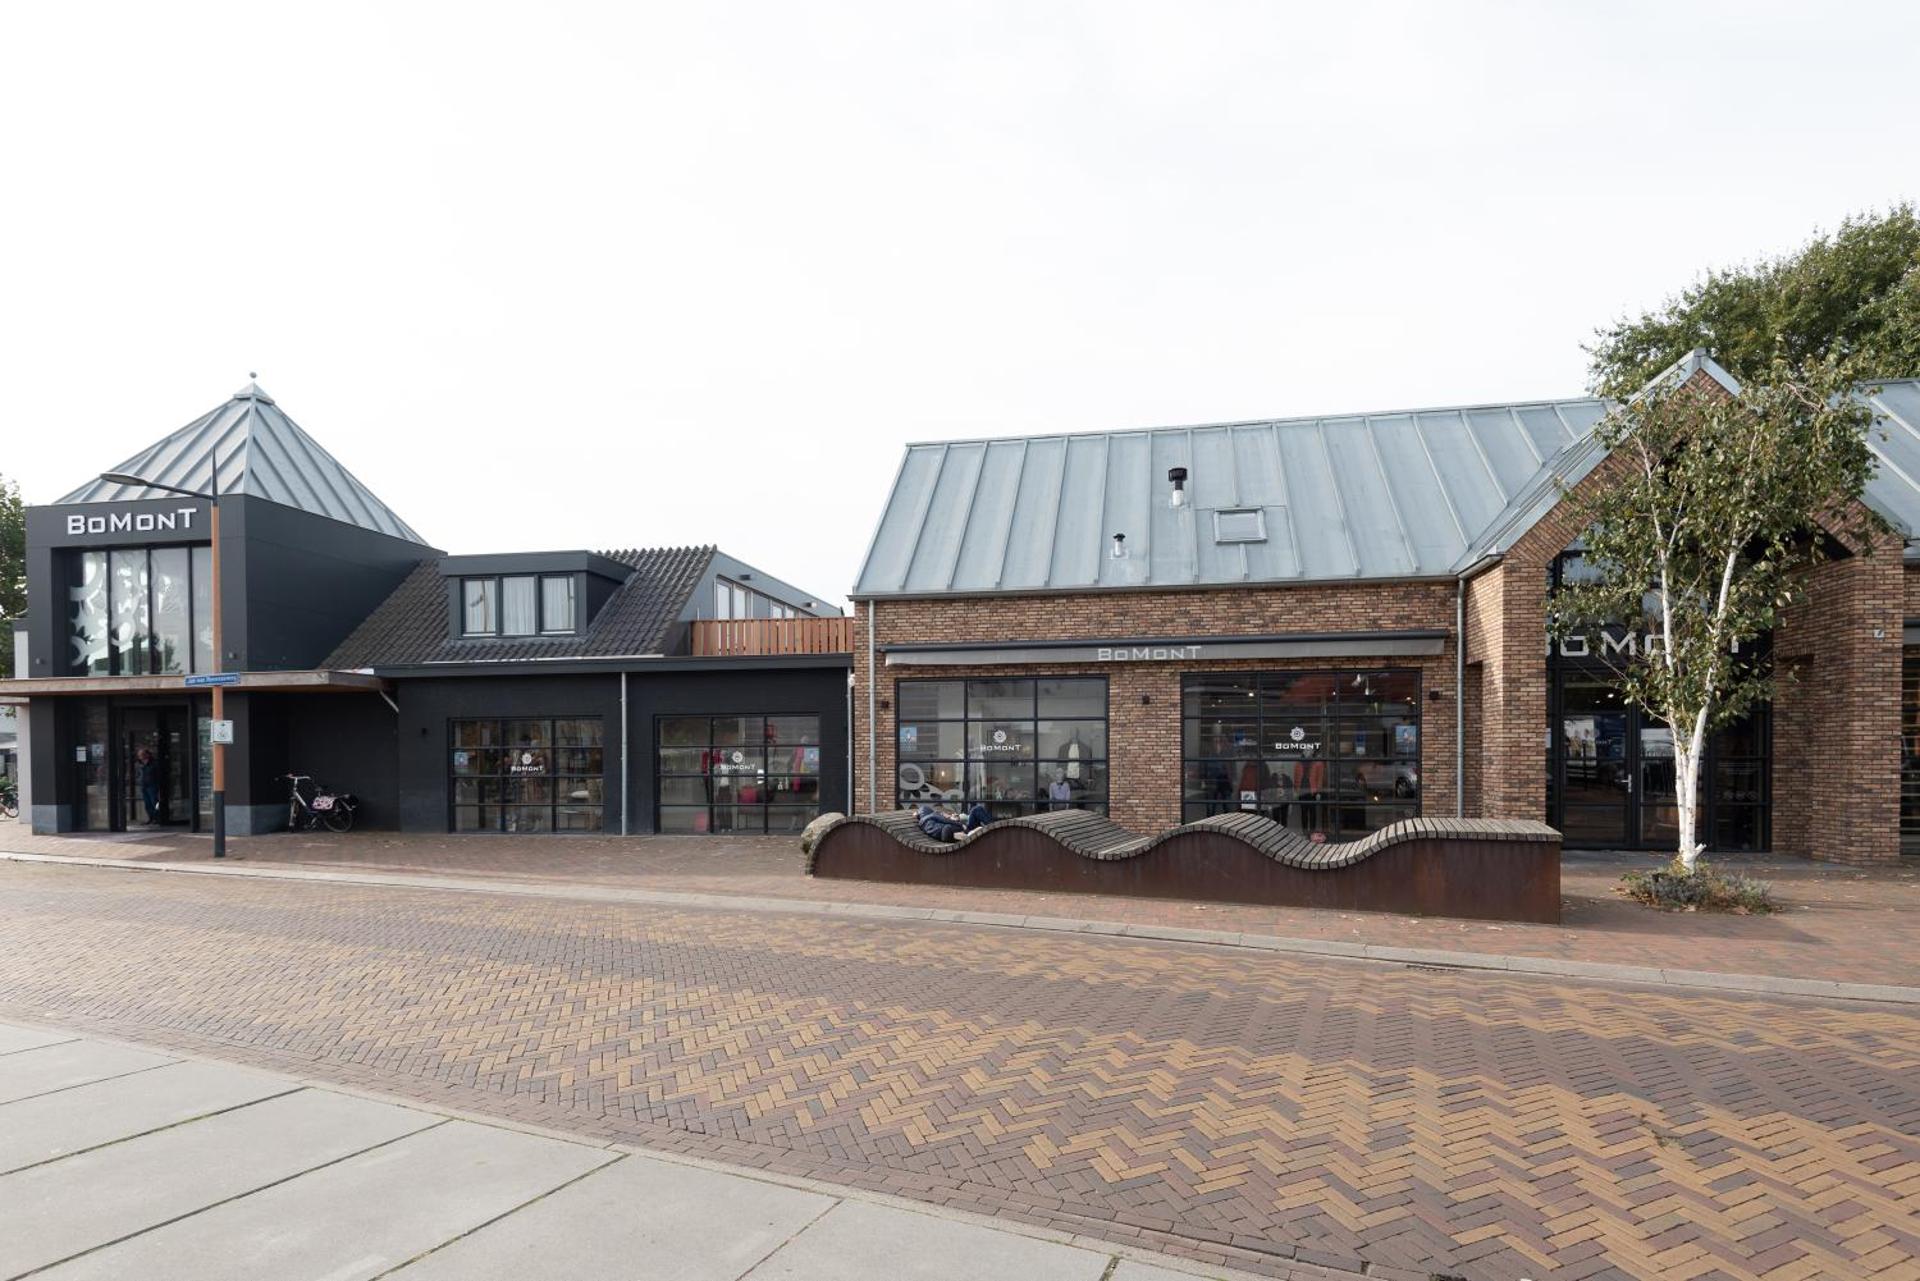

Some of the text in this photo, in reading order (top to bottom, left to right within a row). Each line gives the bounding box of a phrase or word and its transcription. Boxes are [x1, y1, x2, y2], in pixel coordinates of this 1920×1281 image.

[67, 508, 197, 535] BOMONT
[1098, 646, 1201, 661] BOMONT
[1546, 630, 1740, 657] OMO
[1275, 742, 1321, 750] BOMONT
